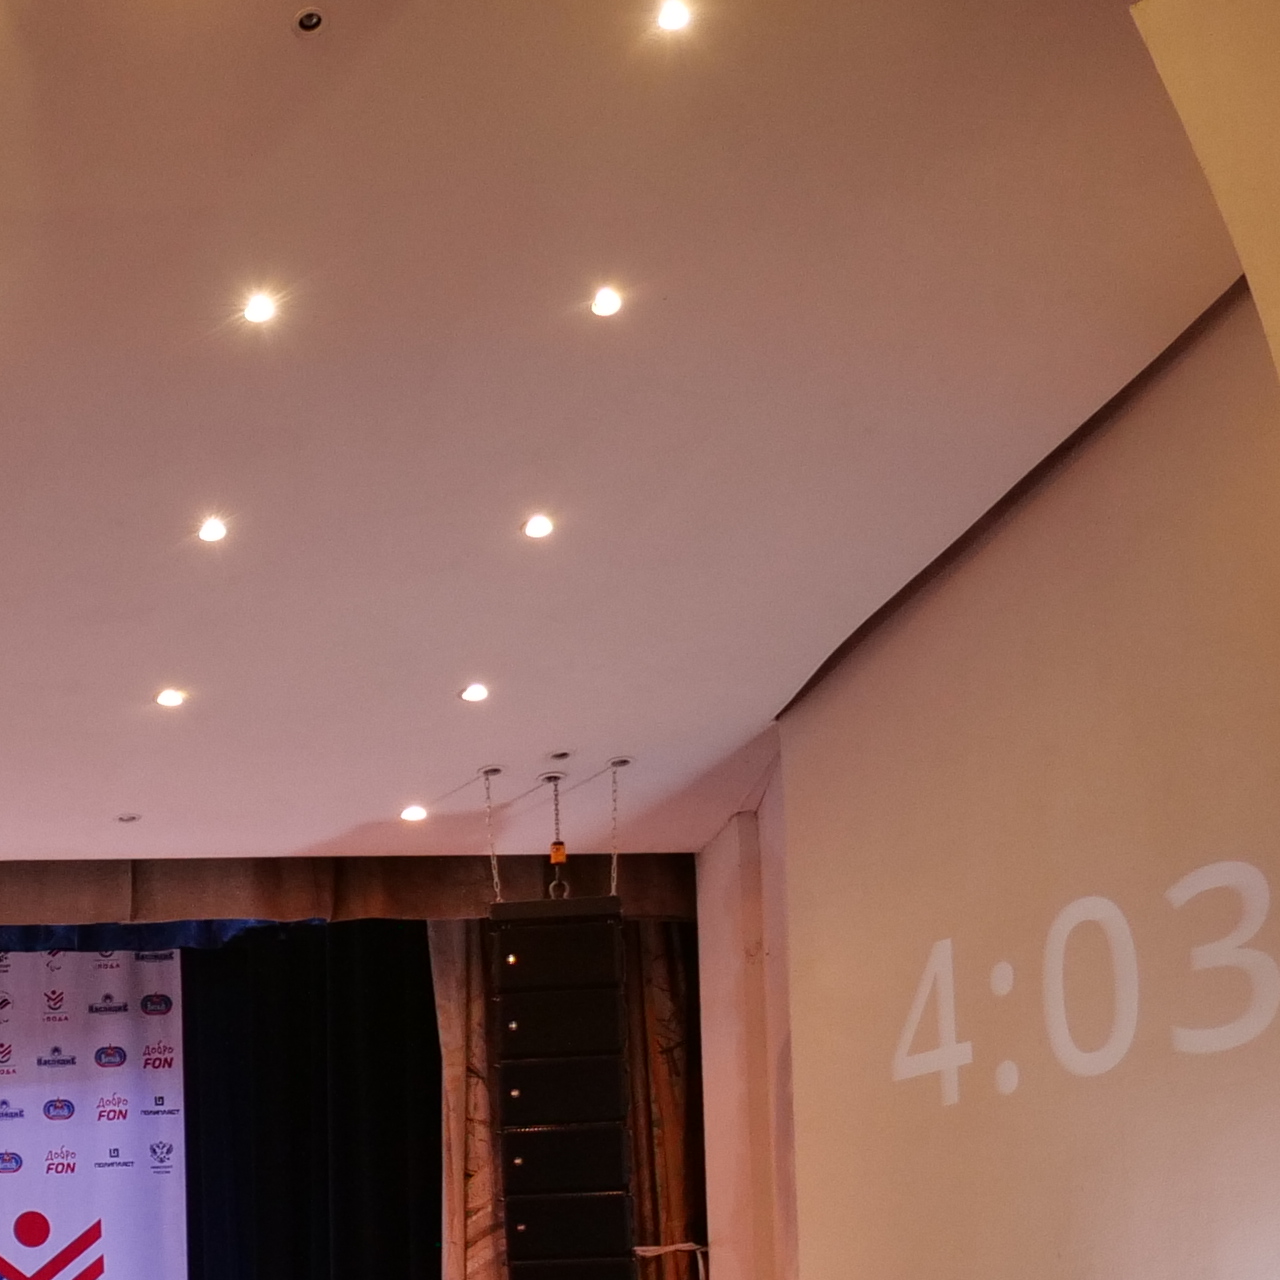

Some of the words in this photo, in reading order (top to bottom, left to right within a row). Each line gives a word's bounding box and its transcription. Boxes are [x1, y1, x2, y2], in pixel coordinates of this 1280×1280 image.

[892, 860, 1280, 1107] 4:03
[143, 1057, 174, 1069] FON
[97, 1109, 128, 1121] FON
[46, 1162, 76, 1174] FON
